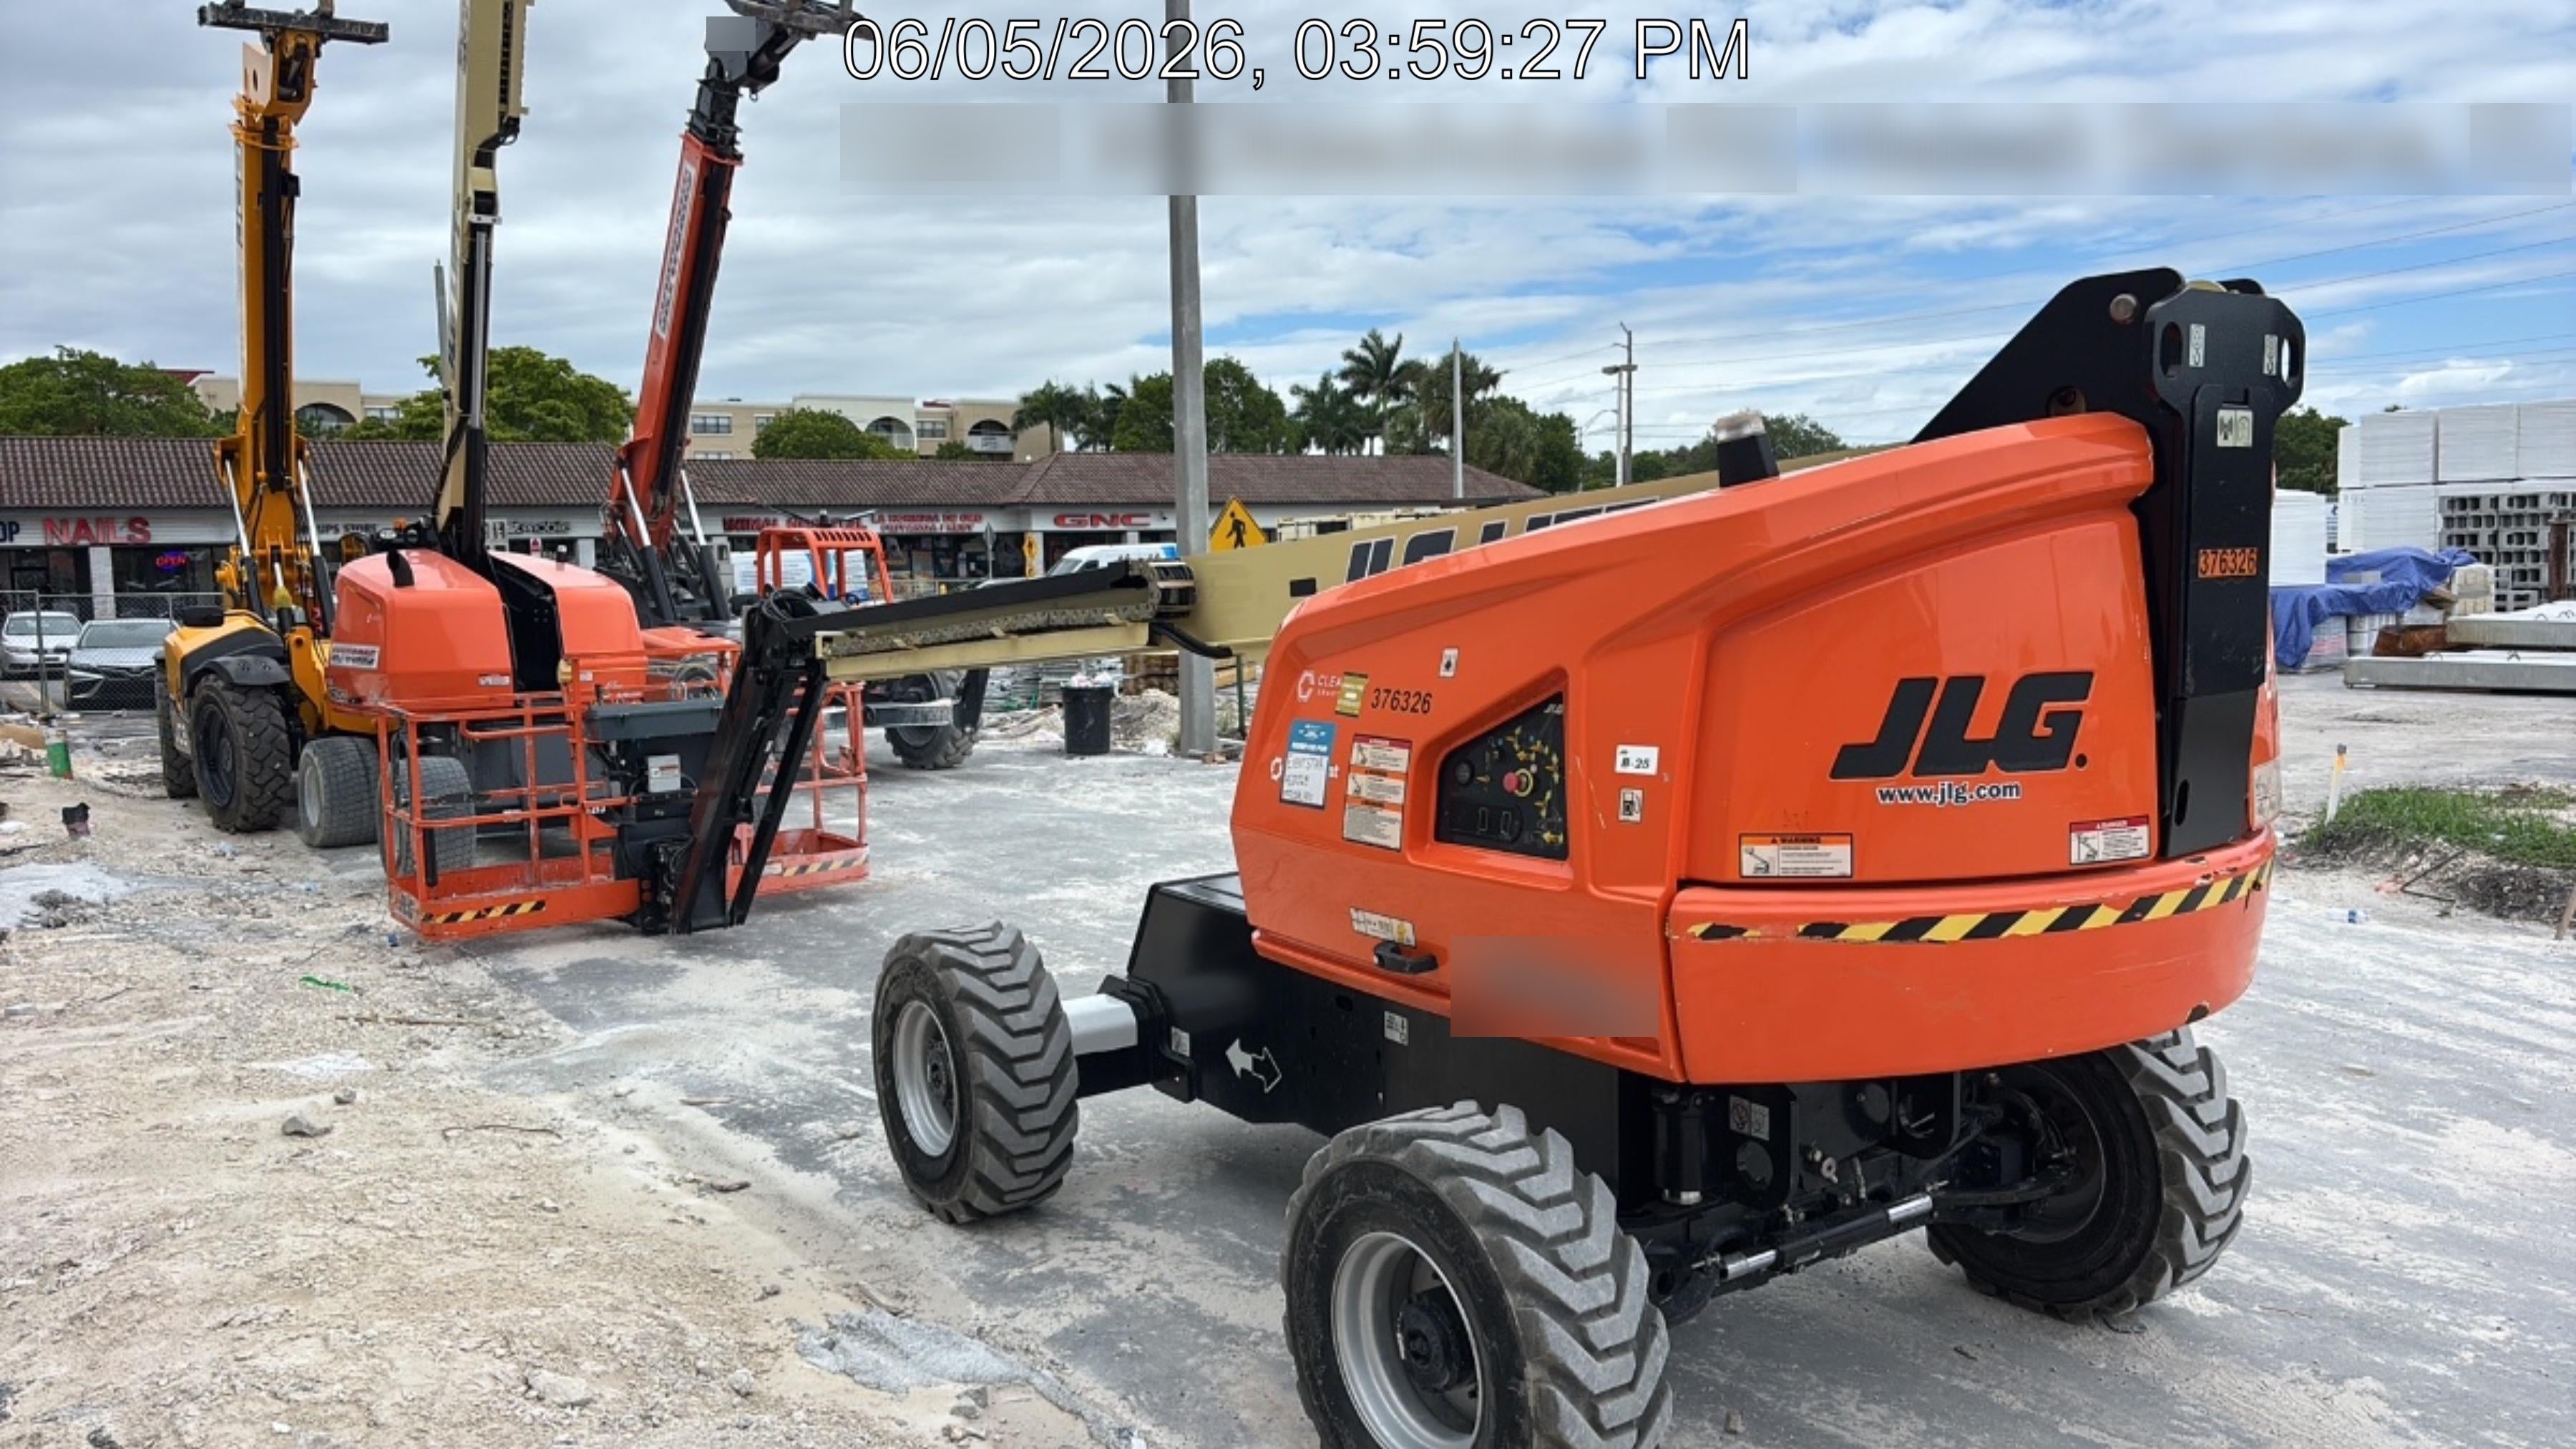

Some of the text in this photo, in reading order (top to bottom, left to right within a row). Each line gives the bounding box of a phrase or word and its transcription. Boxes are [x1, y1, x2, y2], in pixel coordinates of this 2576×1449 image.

[43, 517, 152, 545] NAILS
[1054, 513, 1151, 528] GNC
[155, 556, 189, 567] OPEN
[2200, 549, 2258, 575] 376326
[1371, 688, 1433, 714] 376326
[1878, 782, 2021, 807] www.jlg.com
